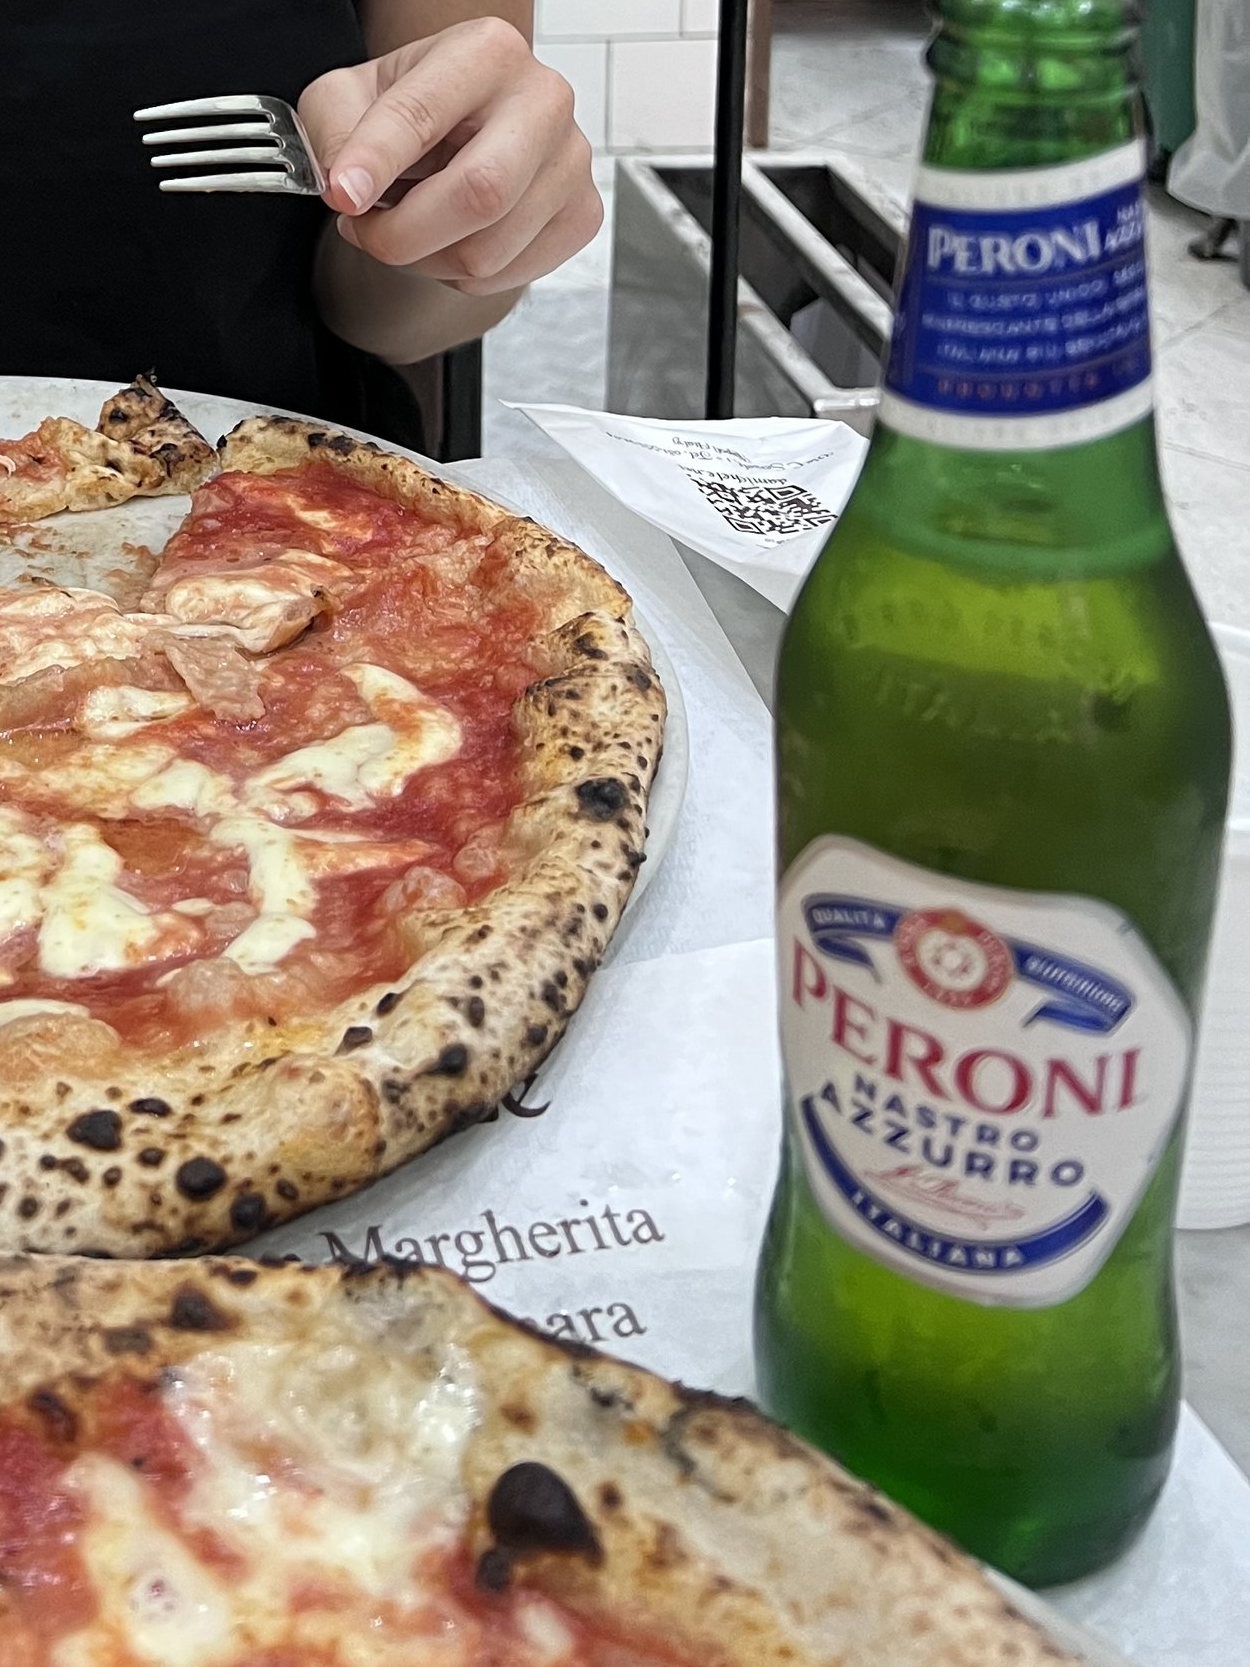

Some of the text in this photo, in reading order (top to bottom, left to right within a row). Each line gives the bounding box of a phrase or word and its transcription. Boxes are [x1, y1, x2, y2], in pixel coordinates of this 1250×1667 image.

[927, 220, 1100, 274] PERONI
[791, 937, 1145, 1120] PERONI
[820, 1080, 1085, 1187] AZZURRO
[854, 1073, 1040, 1152] NASTRO
[320, 1199, 666, 1283] Margherita
[851, 1192, 1024, 1269] ITALIANA
